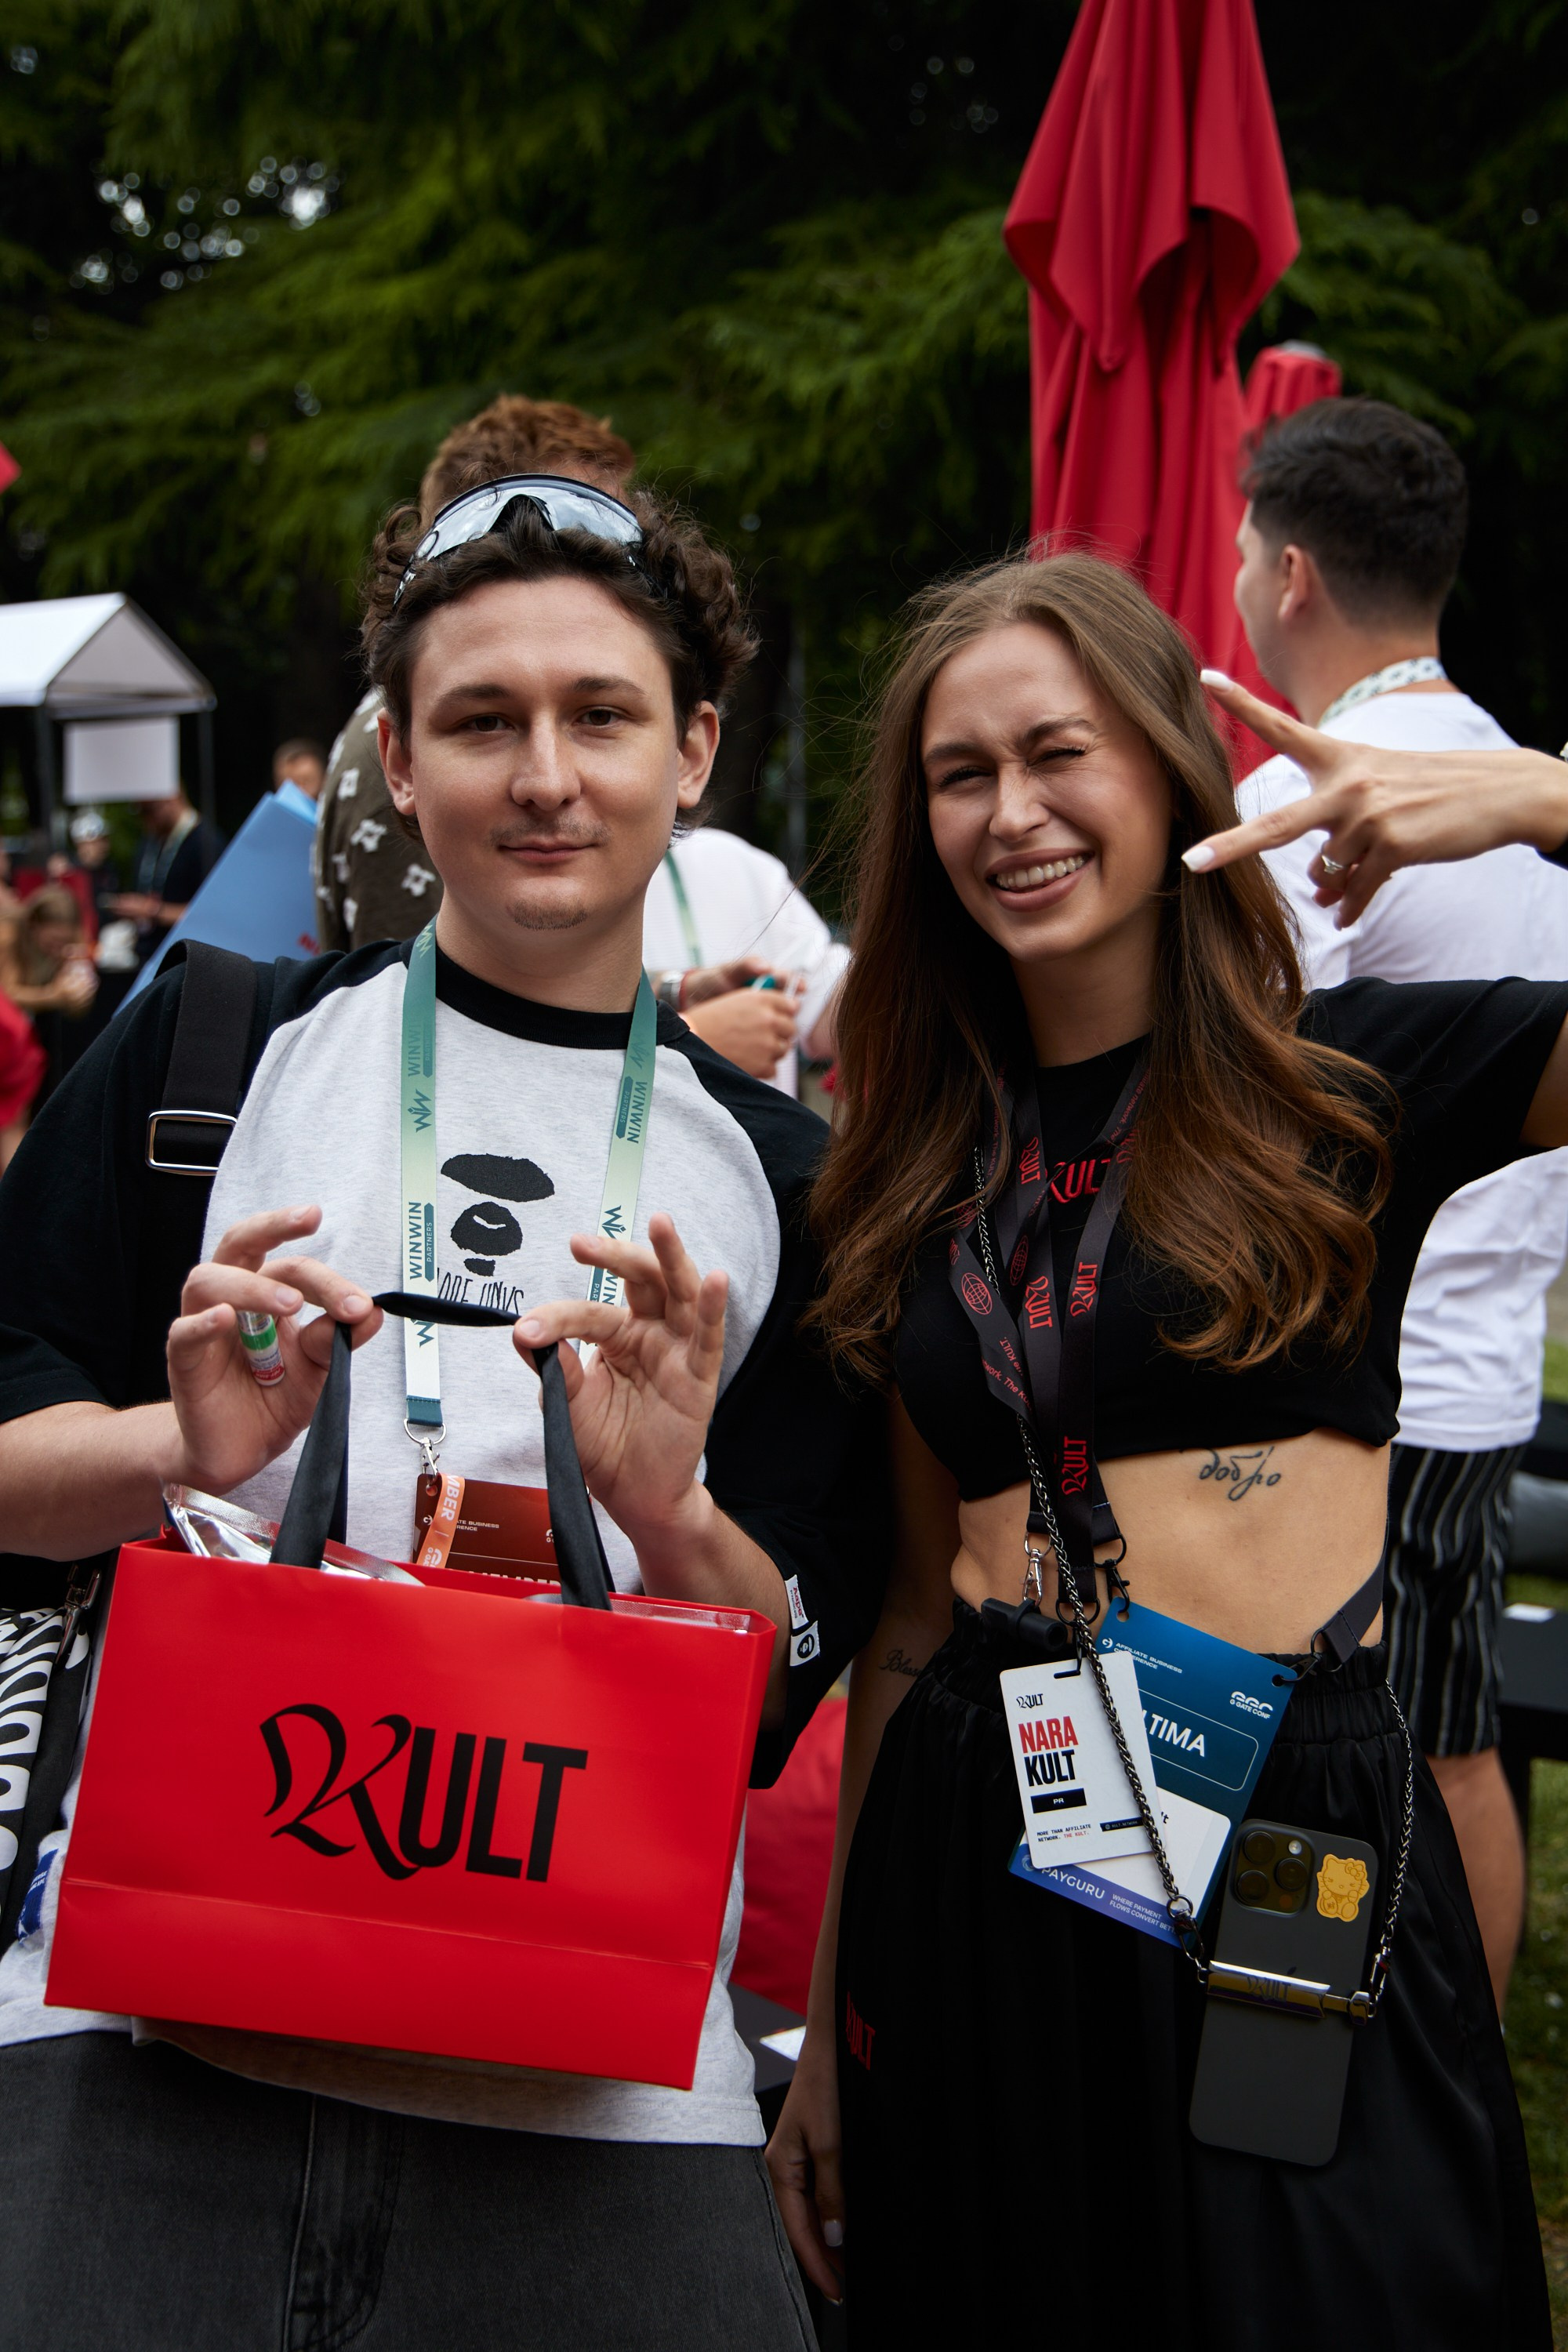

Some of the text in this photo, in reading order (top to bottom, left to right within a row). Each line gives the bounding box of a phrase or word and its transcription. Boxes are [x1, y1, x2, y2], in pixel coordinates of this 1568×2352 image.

[619, 1091, 630, 1124] PARTNERS
[626, 1080, 648, 1145] WINWIN
[1019, 1136, 1041, 1185] KULT
[408, 1202, 423, 1280] WINWIN
[1024, 1275, 1053, 1329] KULT
[1069, 1261, 1098, 1317] KULT
[1004, 1377, 1019, 1393] The
[1061, 1436, 1090, 1496] KULT
[1116, 1642, 1183, 1674] AFFILIATE BUSINESS
[1016, 1693, 1044, 1708] KULT
[1236, 1701, 1252, 1713] GATE
[1252, 1708, 1271, 1719] CONF
[1018, 1715, 1079, 1754] NARA
[1024, 1749, 1076, 1787] KULT
[260, 1703, 589, 1882] KULT
[1065, 1824, 1091, 1832] AFFILIATE
[1109, 1900, 1131, 1914] FLOWS
[1131, 1909, 1159, 1926] CONVERT
[1112, 1893, 1163, 1919] WHERE PAYMENT
